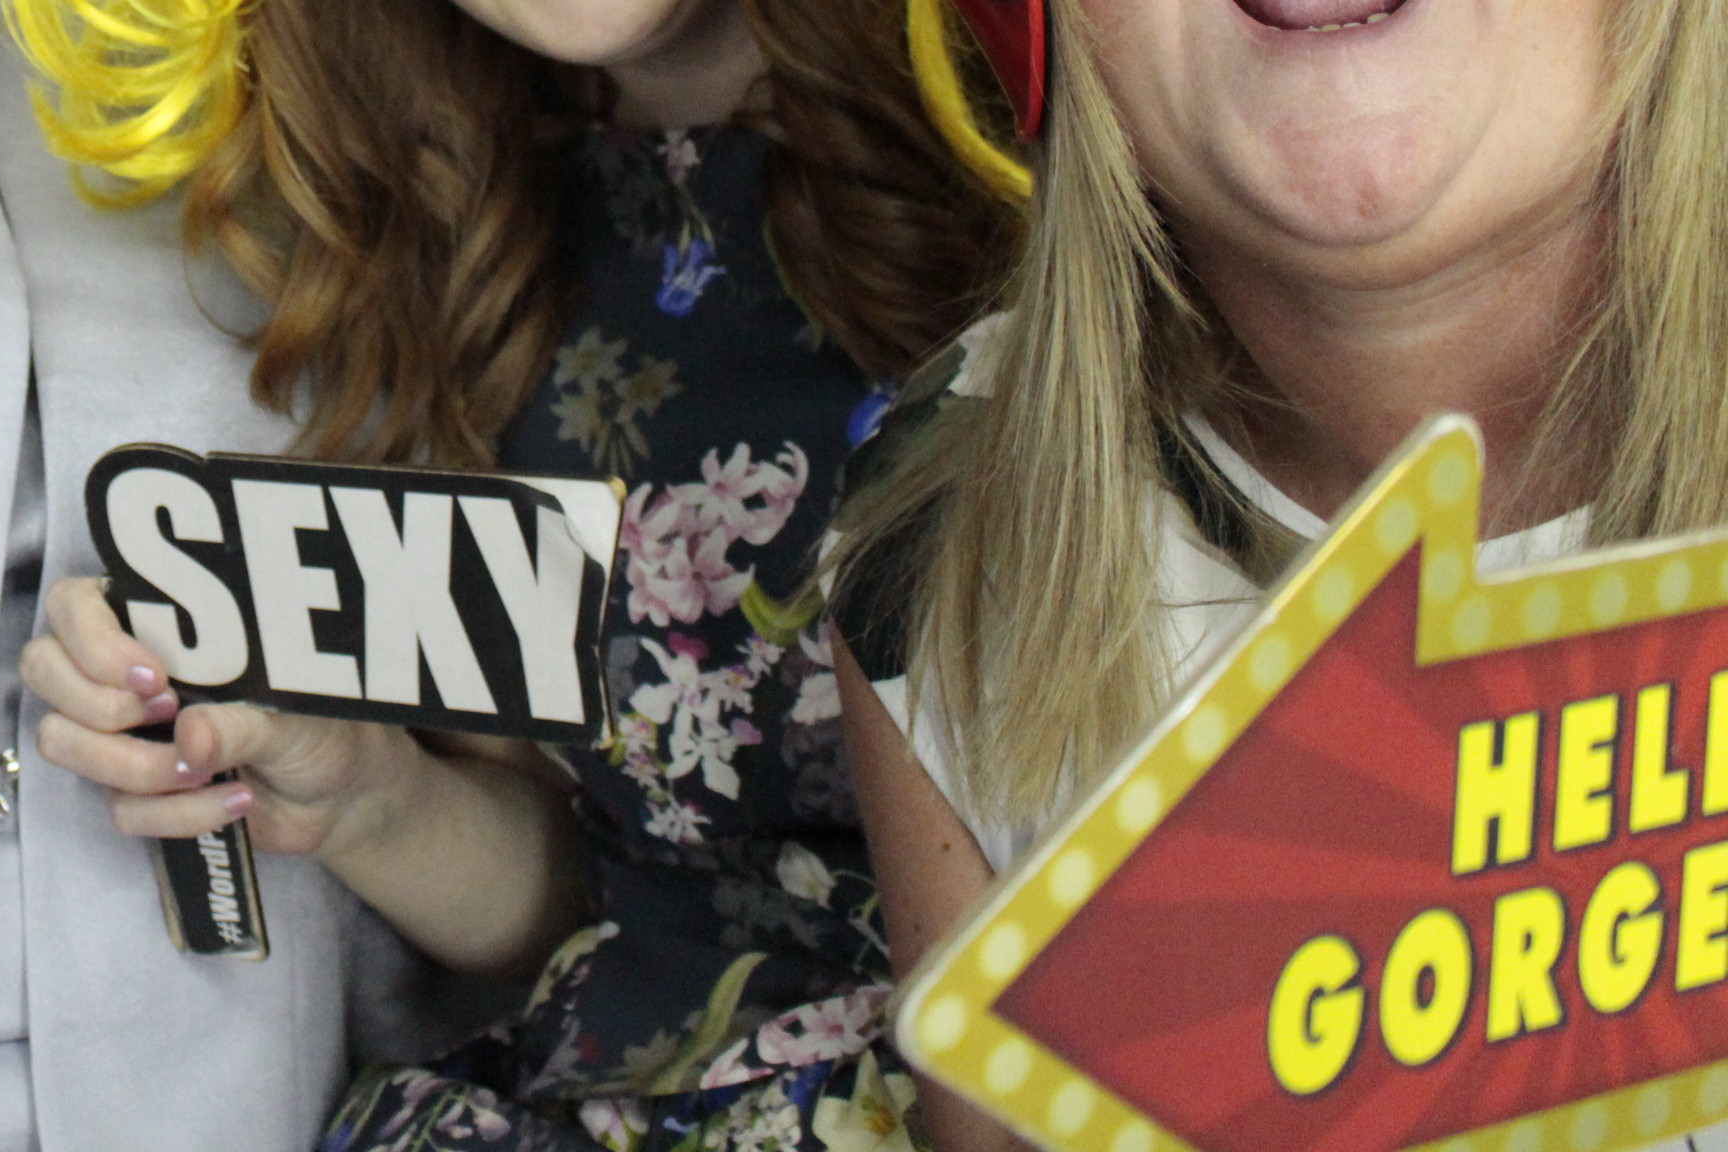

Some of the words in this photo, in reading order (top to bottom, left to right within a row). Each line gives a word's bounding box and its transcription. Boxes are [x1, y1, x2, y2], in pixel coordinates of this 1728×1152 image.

[105, 466, 587, 725] SEXY
[196, 828, 244, 944] #WordP
[1267, 840, 1728, 1096] GORGE
